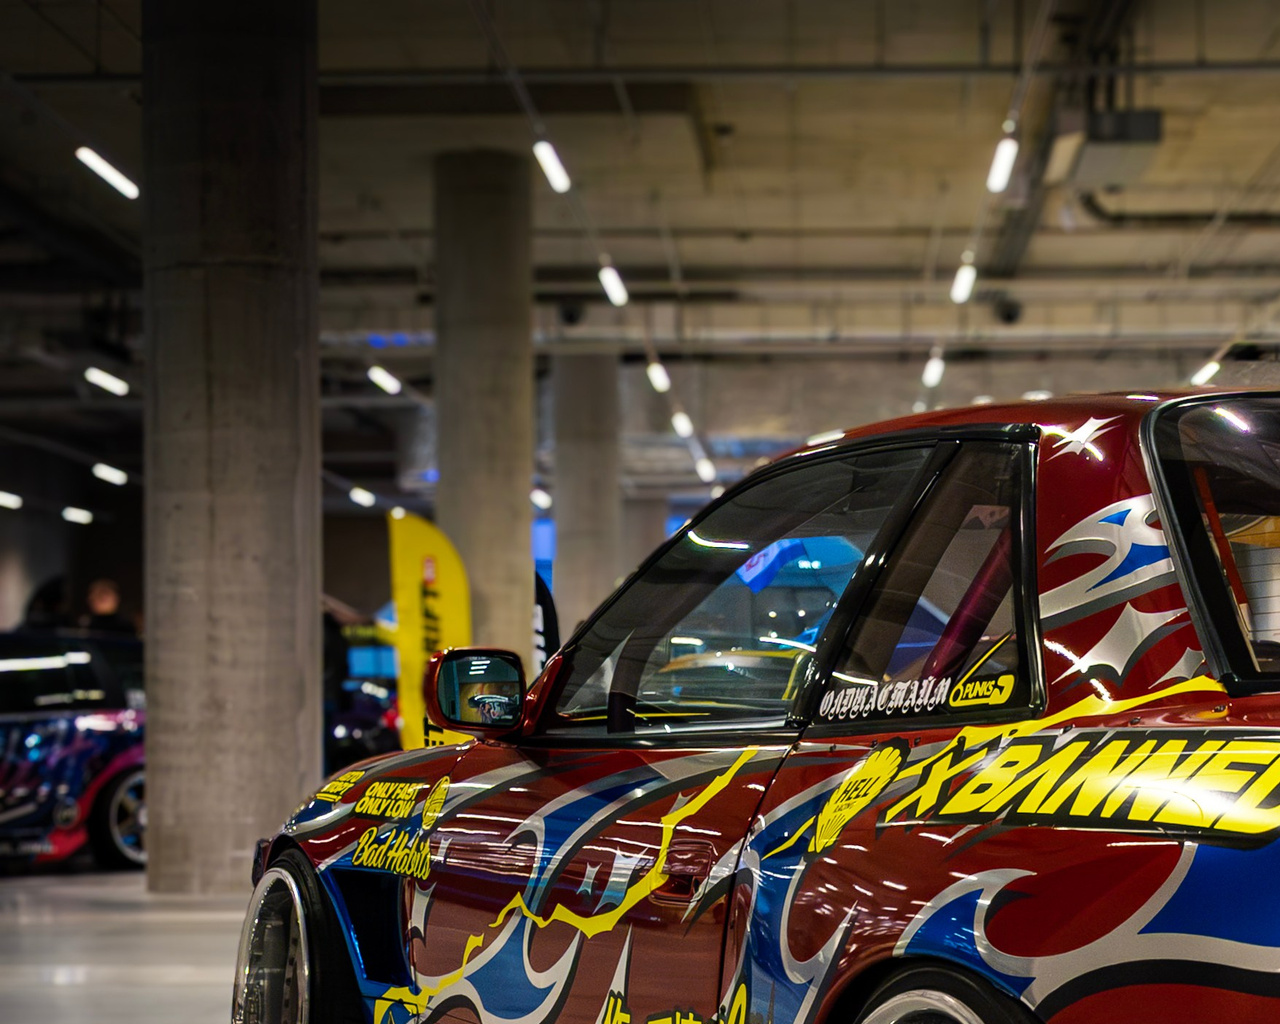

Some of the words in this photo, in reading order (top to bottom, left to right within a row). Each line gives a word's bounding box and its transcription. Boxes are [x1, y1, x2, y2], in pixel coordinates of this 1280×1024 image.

[962, 680, 995, 699] PUNKS
[365, 782, 398, 800] ONLY
[835, 776, 881, 804] HELL
[355, 797, 391, 815] ONLY
[385, 800, 415, 818] LOW
[352, 826, 397, 868] Bad
[385, 829, 431, 880] Habits
